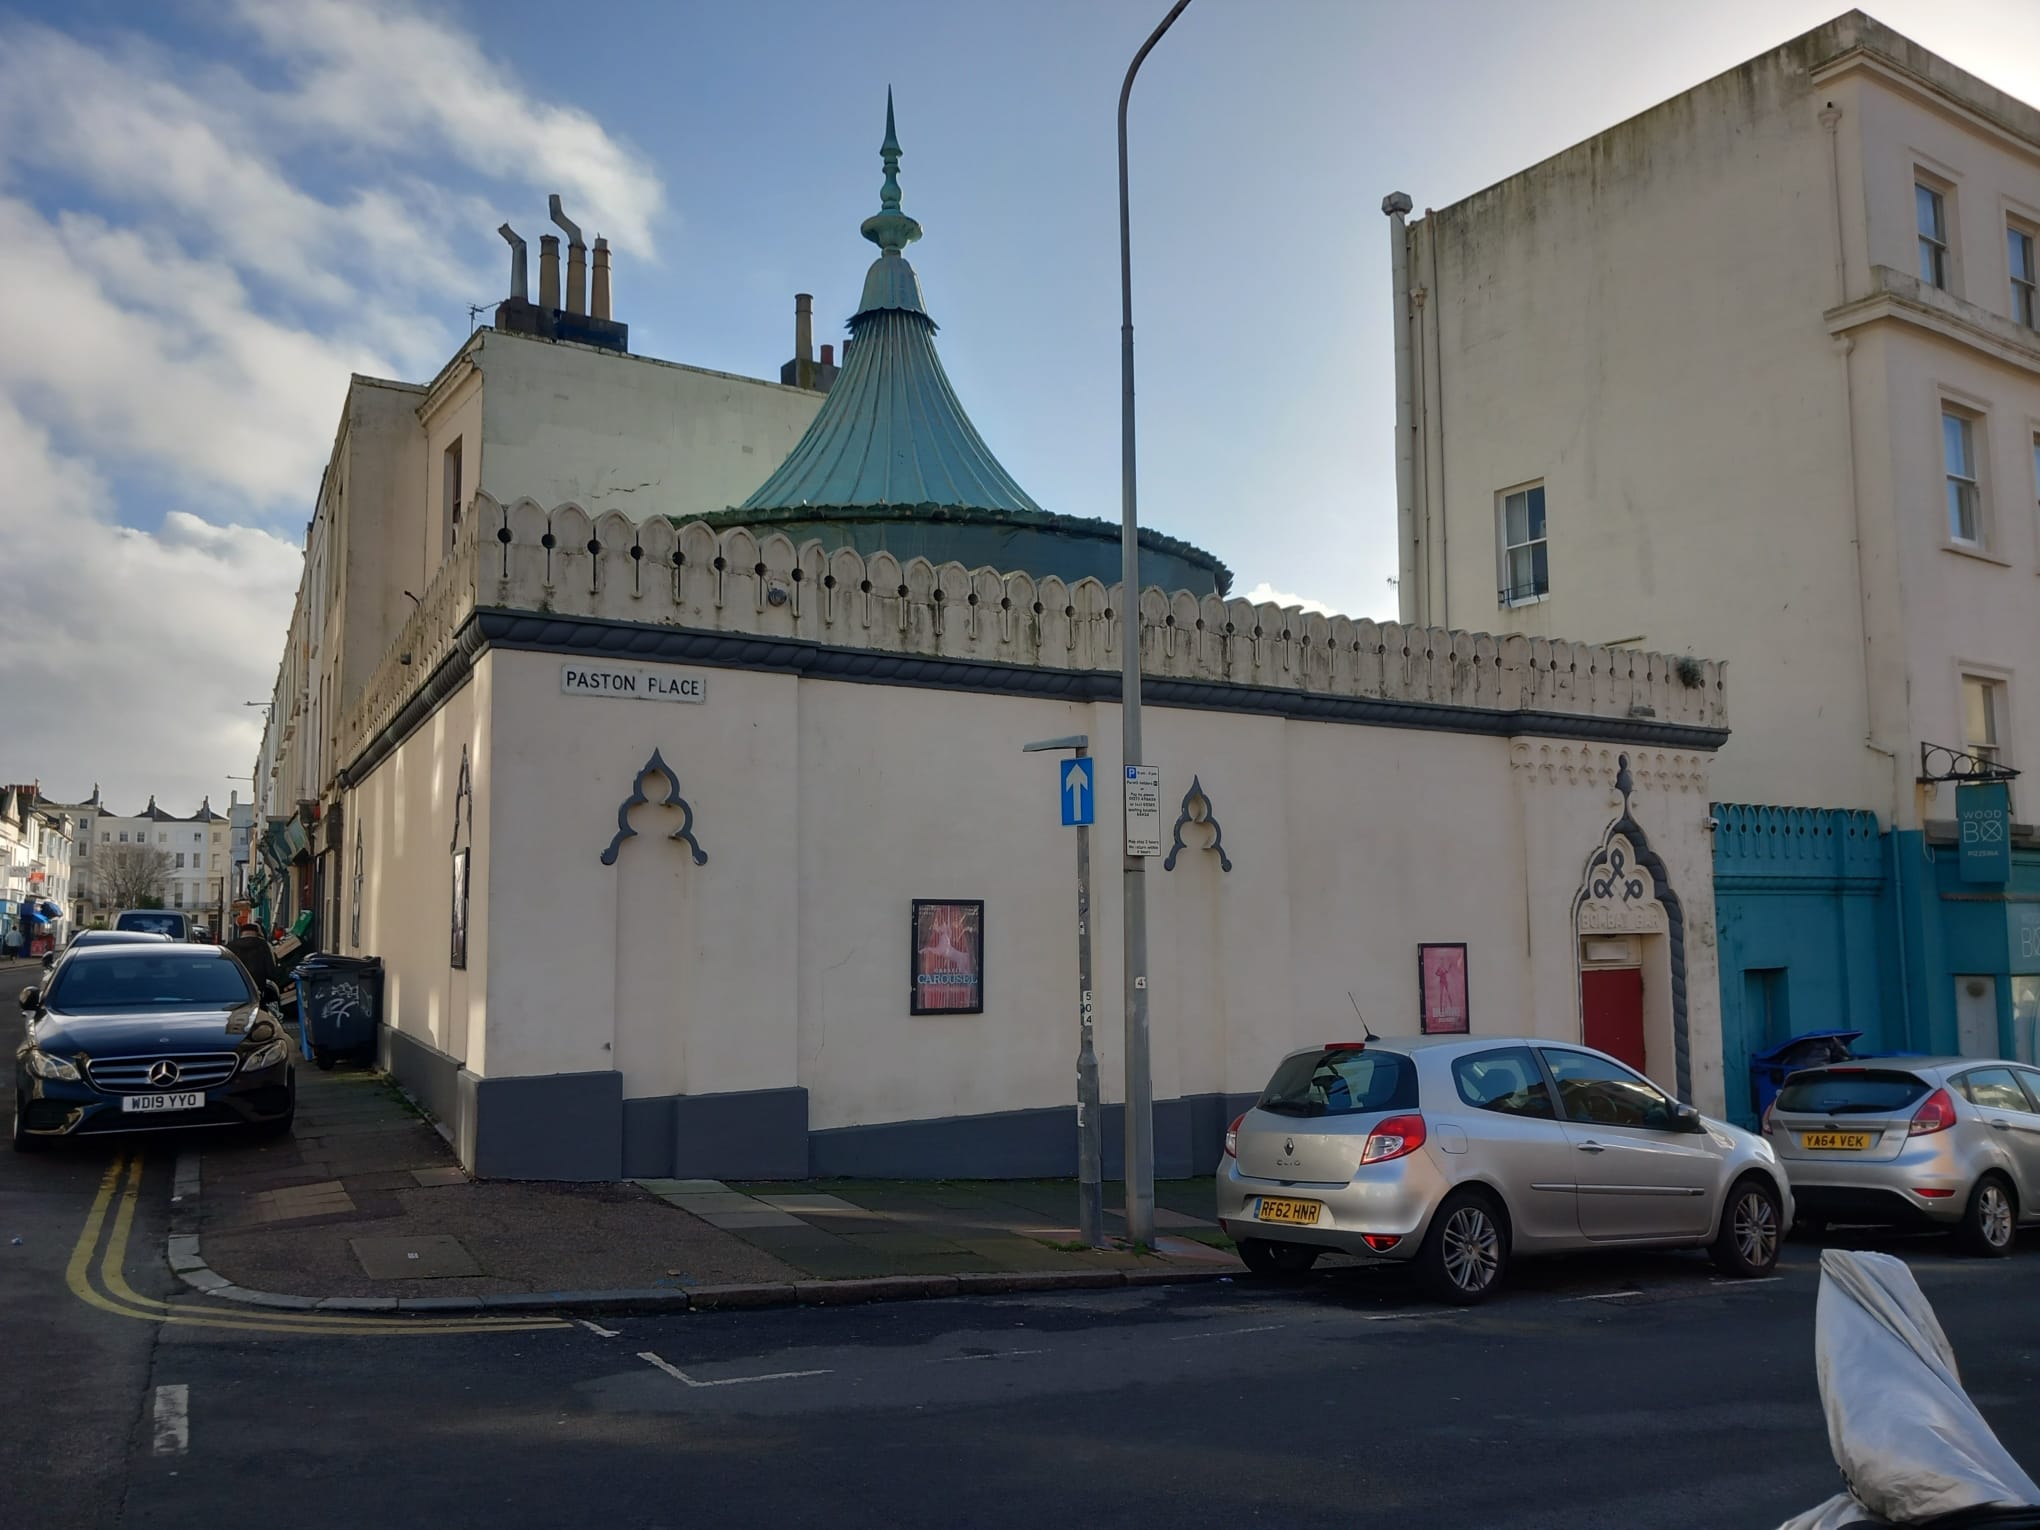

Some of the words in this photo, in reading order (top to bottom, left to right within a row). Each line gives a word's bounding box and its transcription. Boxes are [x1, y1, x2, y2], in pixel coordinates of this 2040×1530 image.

[566, 671, 636, 691] PASTON
[648, 677, 700, 696] PLACE
[1963, 809, 2002, 819] WOOD
[917, 974, 977, 985] CAROUSEL
[132, 1096, 164, 1109] WD19
[169, 1094, 196, 1107] YYO
[1807, 1135, 1836, 1146] YA64
[1840, 1135, 1864, 1147] VEK
[1261, 1201, 1291, 1218] RF62
[1293, 1204, 1317, 1221] HNR
